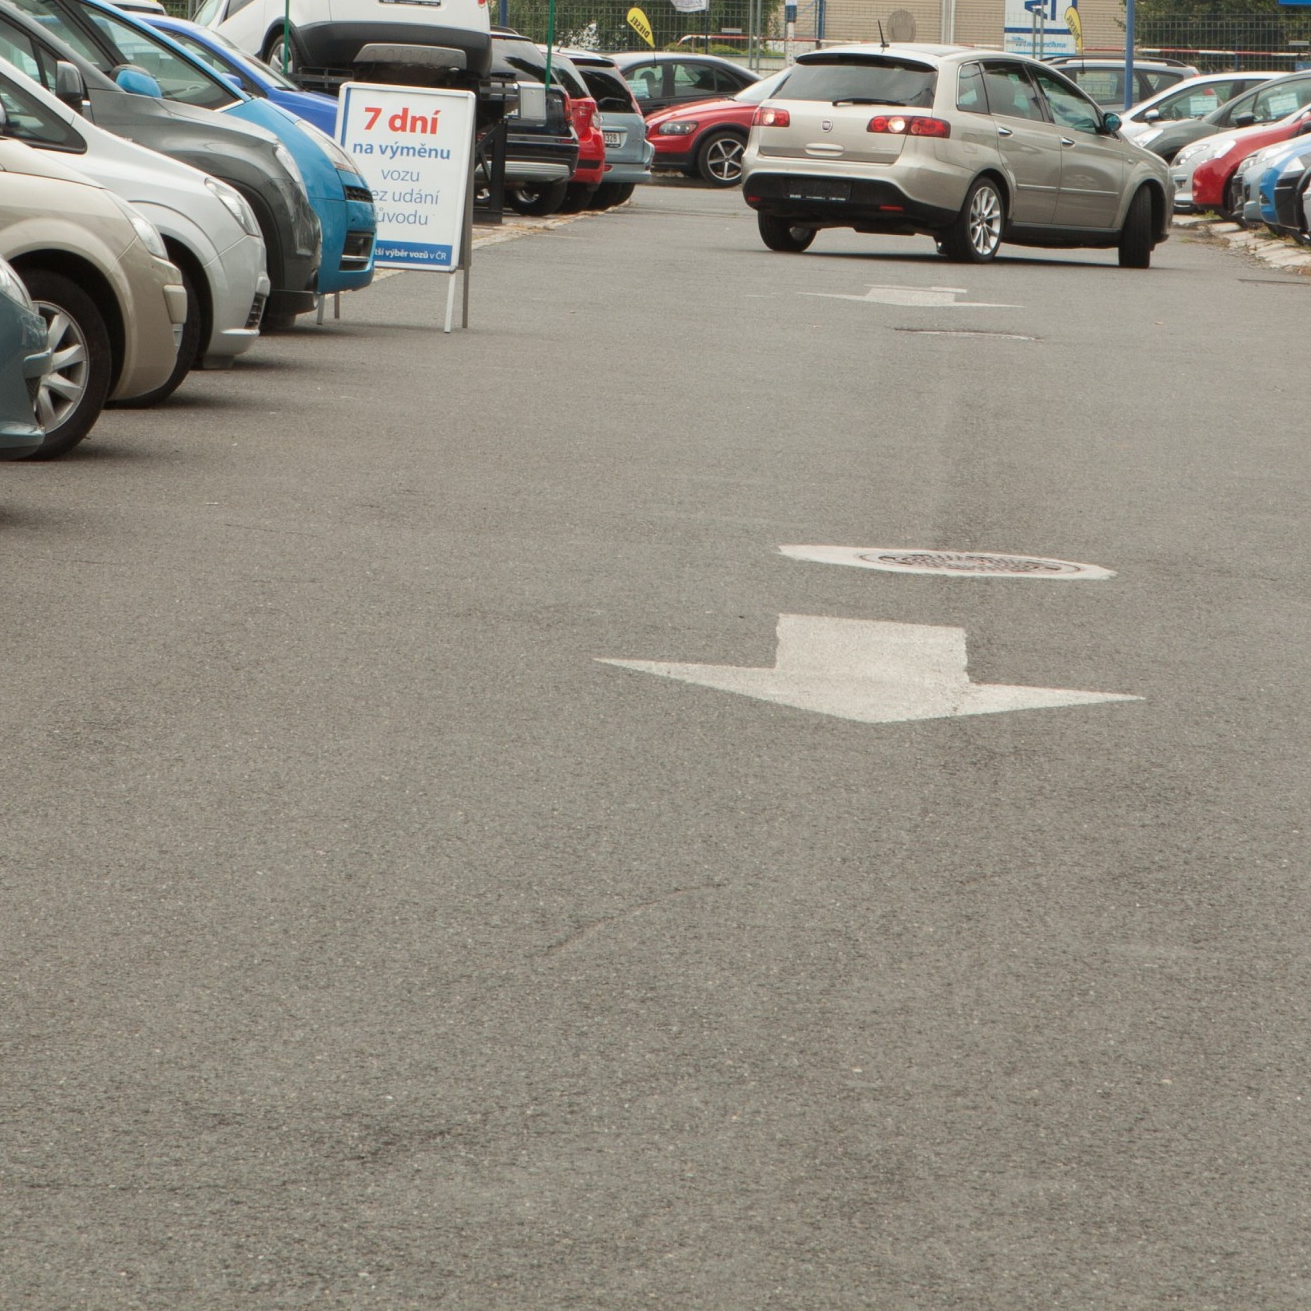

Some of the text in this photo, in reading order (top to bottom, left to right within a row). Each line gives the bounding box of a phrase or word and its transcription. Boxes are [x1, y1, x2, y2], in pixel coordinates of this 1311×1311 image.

[364, 107, 442, 135] 7 dní
[352, 141, 451, 160] na výměnu
[381, 169, 420, 182] vozu
[371, 188, 440, 205] ez udání
[377, 207, 428, 226] ůvodu
[385, 248, 408, 258] výběr
[409, 249, 429, 259] vozů
[435, 250, 447, 260] ČR
